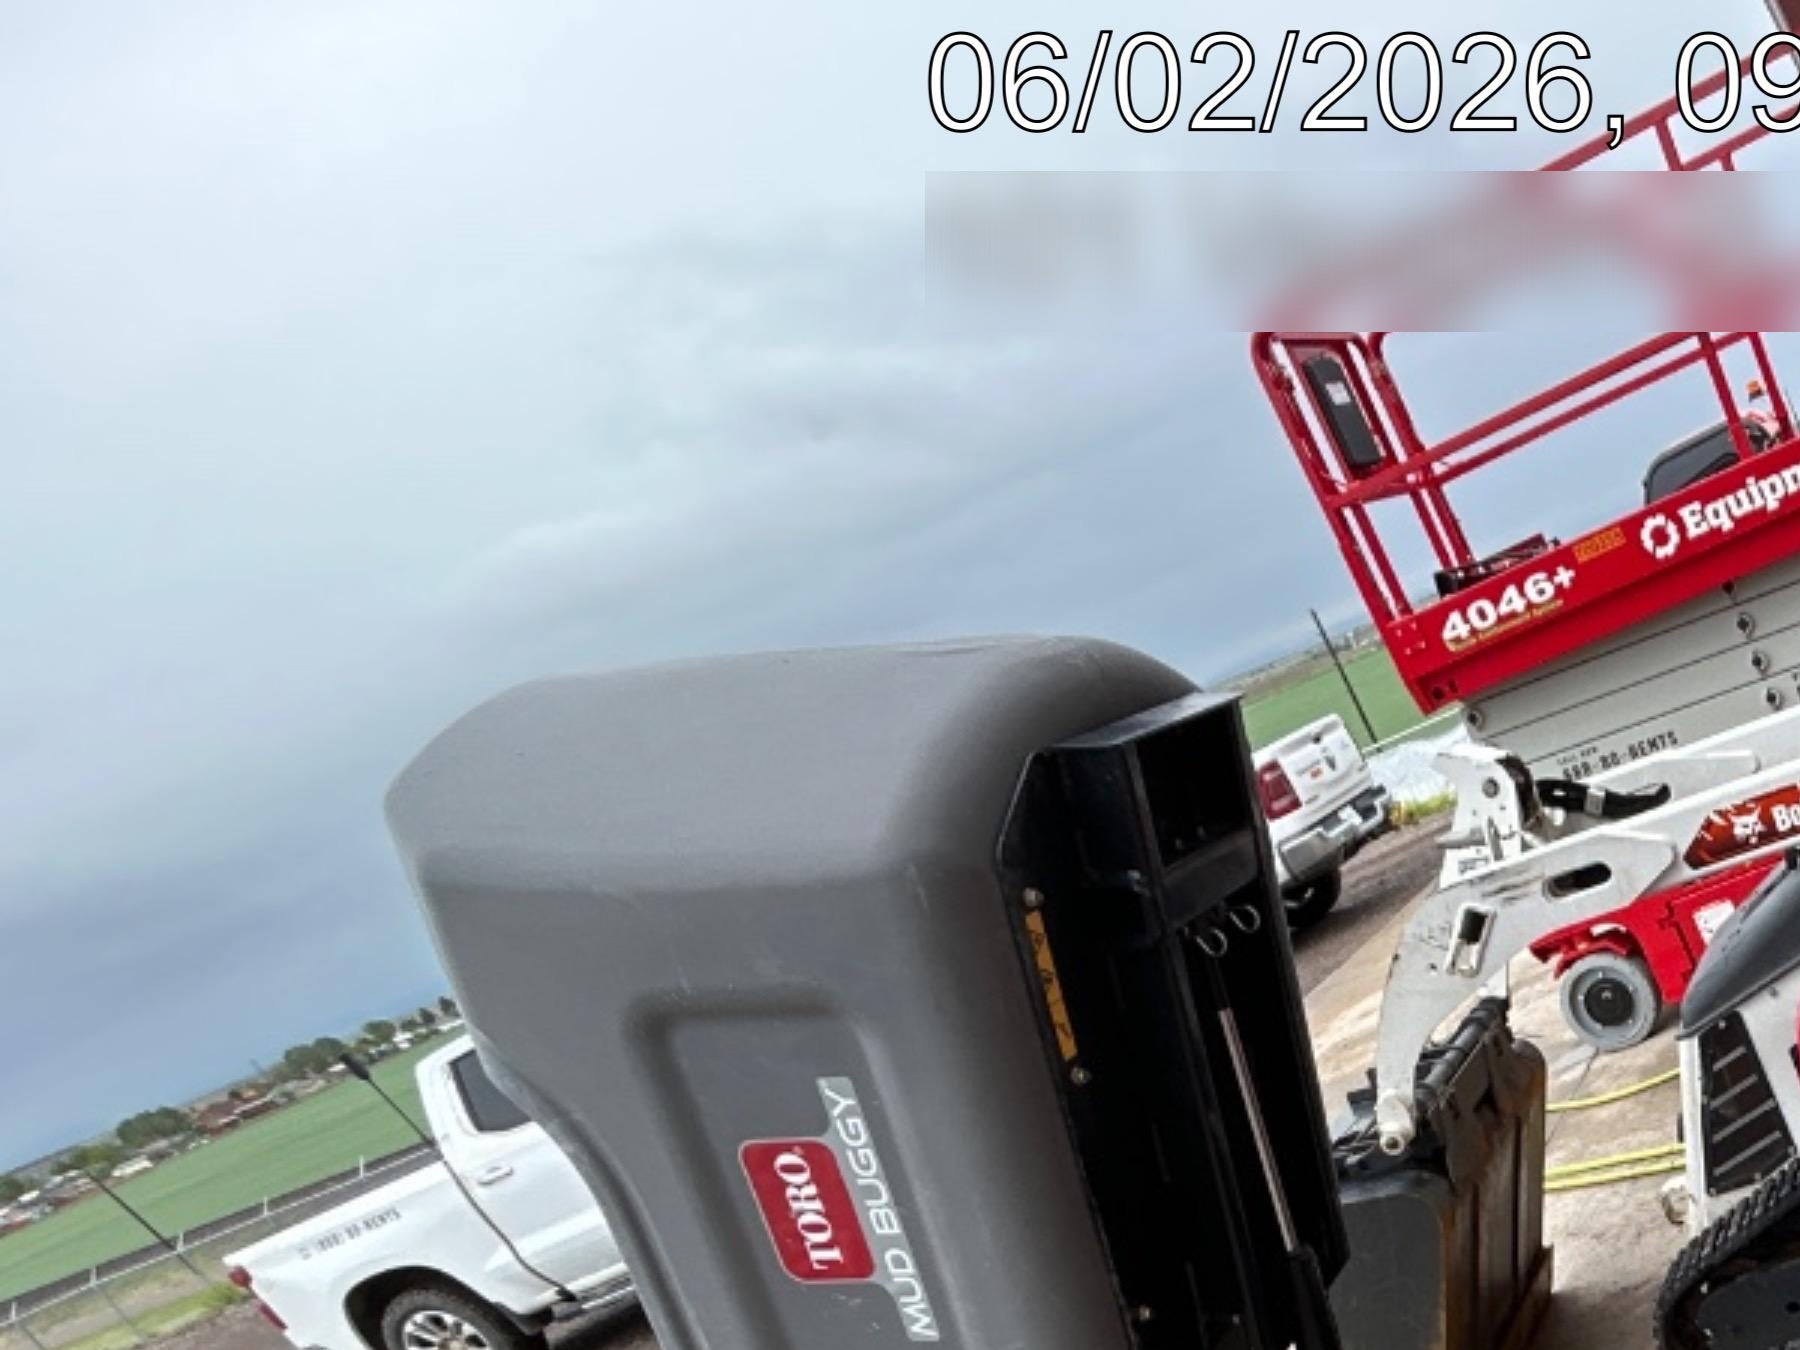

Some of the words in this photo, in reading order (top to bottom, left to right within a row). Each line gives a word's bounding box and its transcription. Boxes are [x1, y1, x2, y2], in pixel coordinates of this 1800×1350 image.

[1442, 566, 1576, 642] 4046+
[773, 1152, 844, 1271] TORO
[823, 1086, 901, 1236] BUGGY
[884, 1248, 938, 1337] MUD
